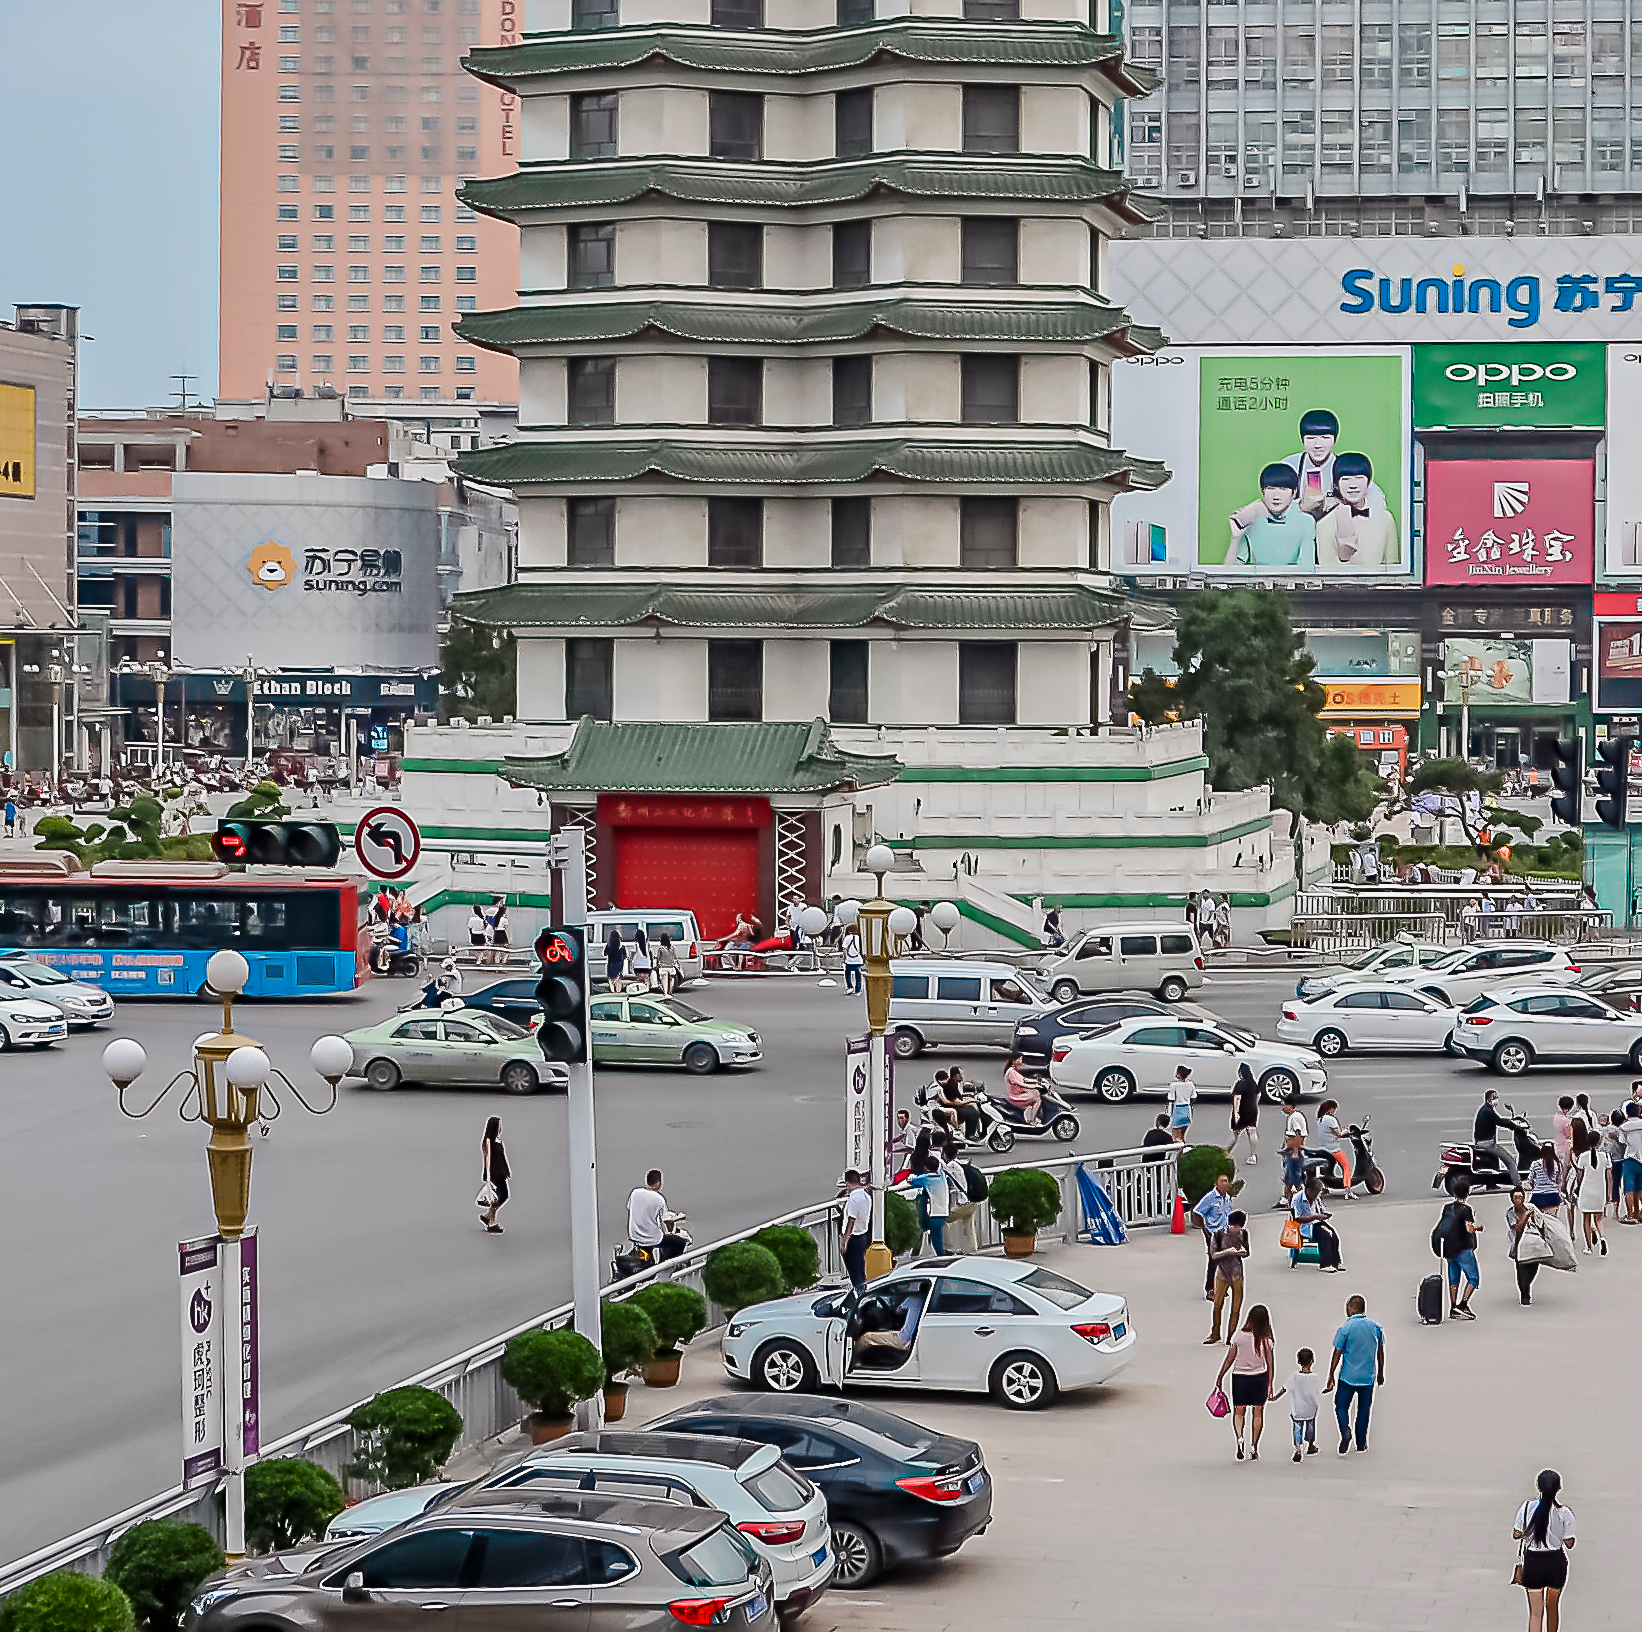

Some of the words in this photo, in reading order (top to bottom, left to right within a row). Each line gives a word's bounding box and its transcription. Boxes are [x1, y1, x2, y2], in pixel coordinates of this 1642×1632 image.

[1338, 264, 1540, 328] Suning
[1217, 377, 1290, 391] 充电5分钟
[1216, 396, 1288, 411] 通话2小时
